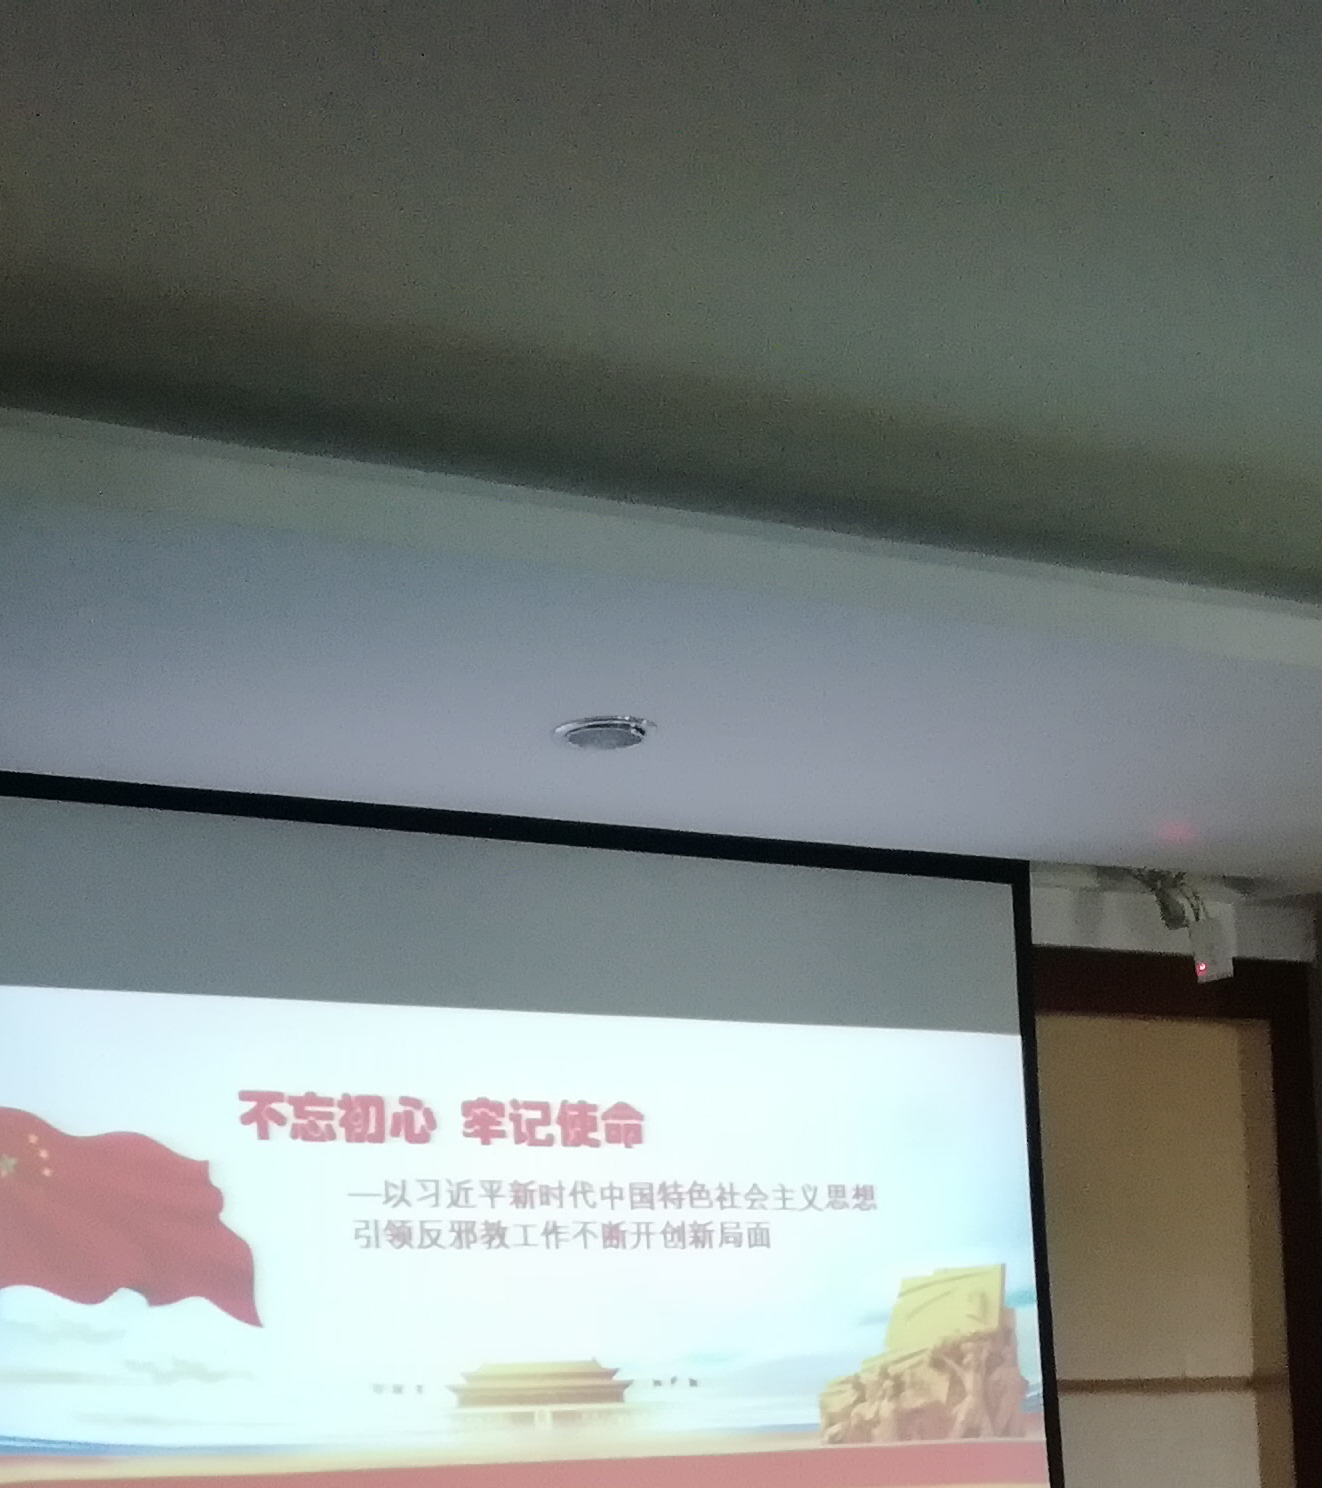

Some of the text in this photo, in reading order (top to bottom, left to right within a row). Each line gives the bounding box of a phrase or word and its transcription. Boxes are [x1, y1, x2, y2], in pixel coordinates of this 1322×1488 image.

[238, 1090, 645, 1149] 不忘初心 牢记使命
[353, 1220, 772, 1250] 引领反邪教工作不断开创新局面
